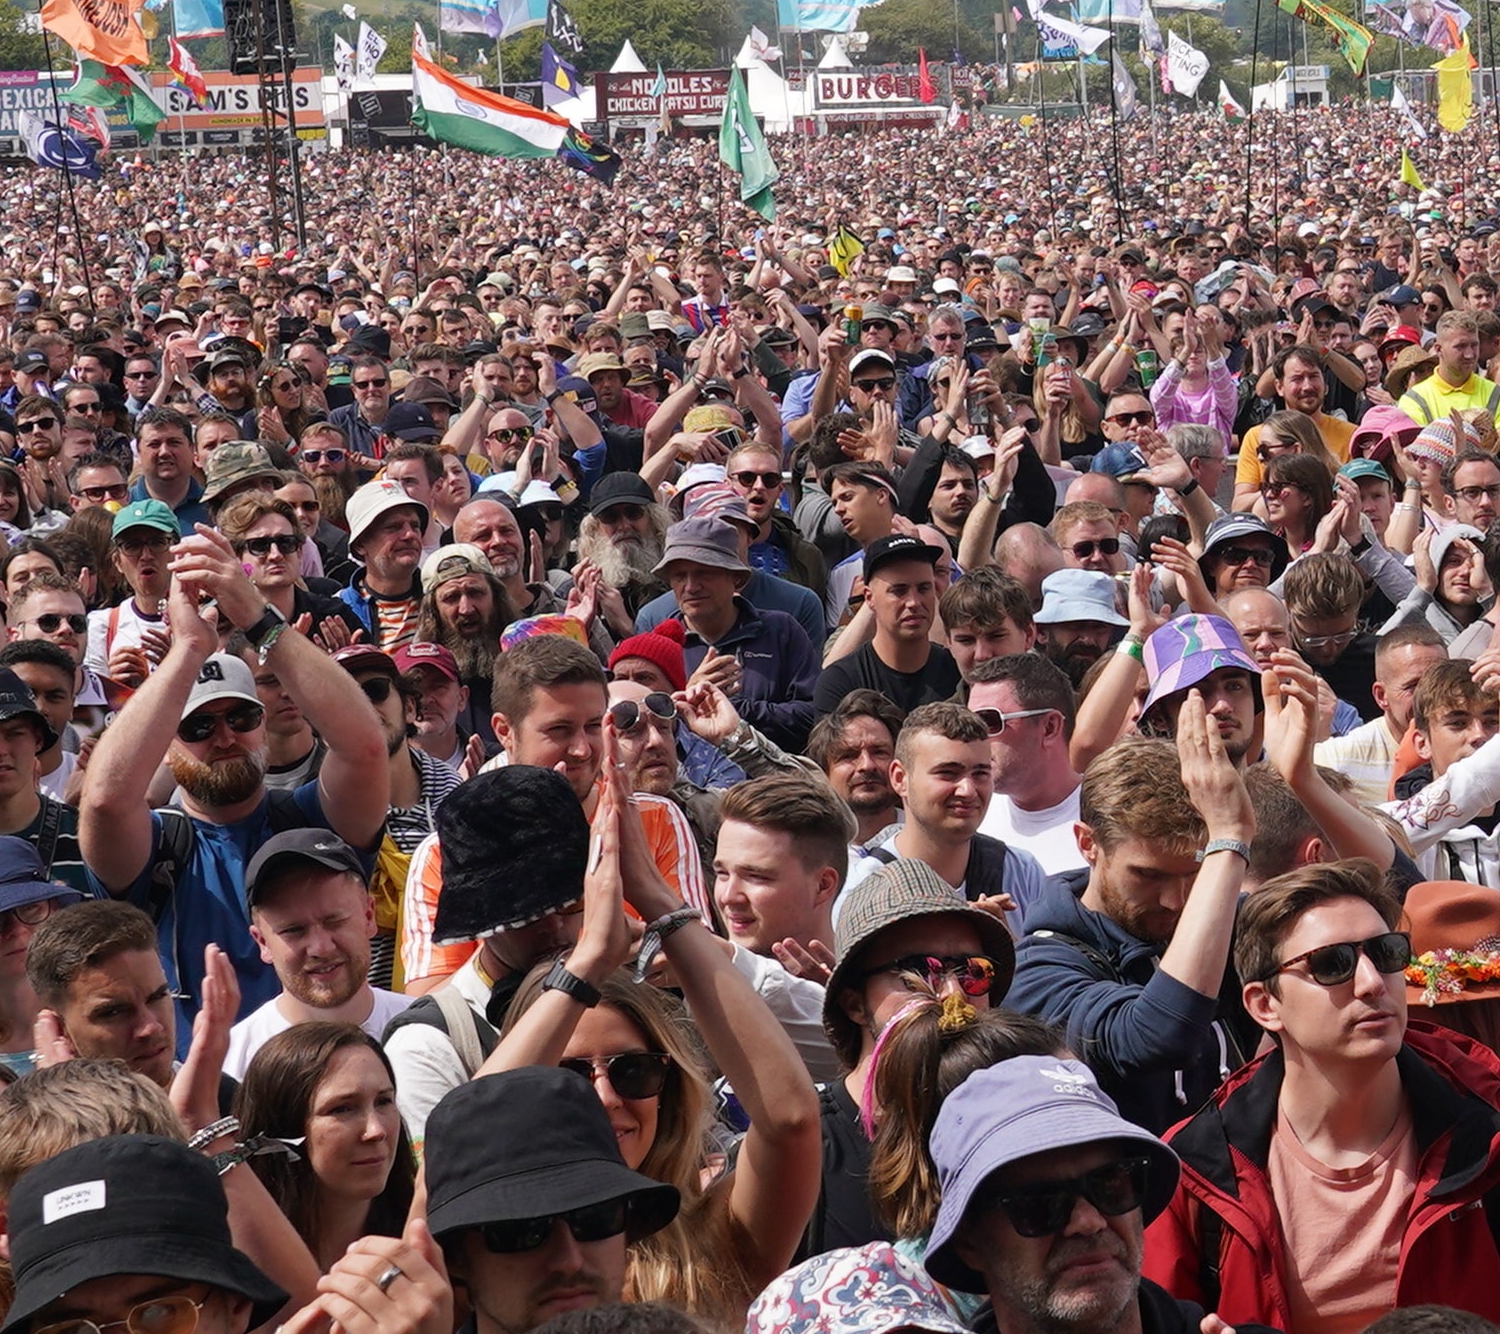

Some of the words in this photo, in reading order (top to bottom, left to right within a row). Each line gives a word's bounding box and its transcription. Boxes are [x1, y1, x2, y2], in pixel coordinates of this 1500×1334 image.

[632, 75, 711, 95] NODLES
[169, 86, 252, 113] SAM'S
[608, 97, 657, 113] CHICKEN
